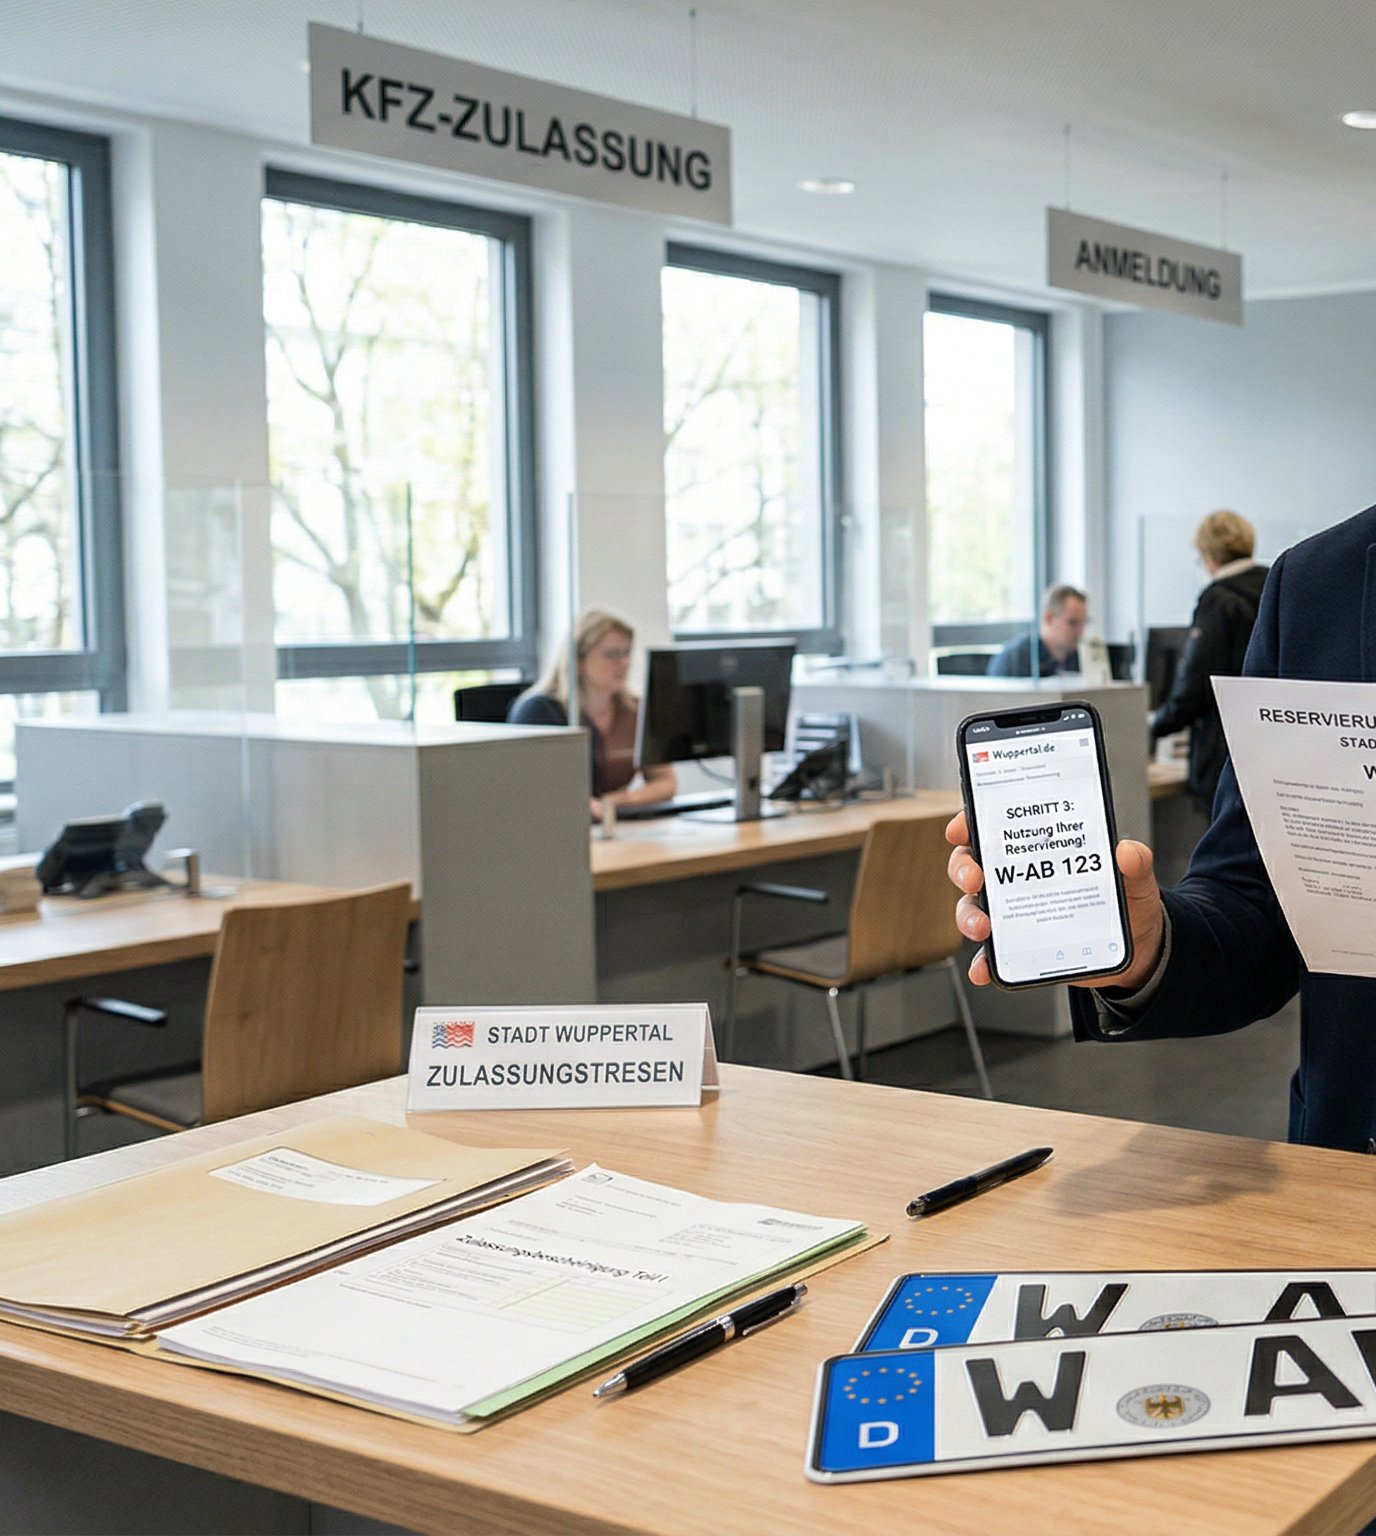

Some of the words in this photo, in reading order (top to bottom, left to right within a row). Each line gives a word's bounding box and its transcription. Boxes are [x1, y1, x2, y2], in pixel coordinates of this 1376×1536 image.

[341, 68, 711, 191] KFZ-ZULASSUNG
[1075, 241, 1221, 300] ANMELDUNG
[993, 744, 1054, 759] Wuppertal.de
[1007, 802, 1059, 819] SCHRITT
[1063, 801, 1074, 811] 3:
[1004, 827, 1053, 840] Nutzung
[1056, 822, 1083, 832] Ihrer
[1006, 832, 1085, 855] Reservierung!
[995, 861, 1054, 884] W-AB
[1062, 854, 1101, 874] 123
[488, 1026, 549, 1043] STADT
[556, 1025, 673, 1042] WUPPERTAL
[427, 1061, 683, 1086] ZULASSUNGSTRESEN
[966, 1351, 1086, 1437] W
[859, 1422, 898, 1448] D
